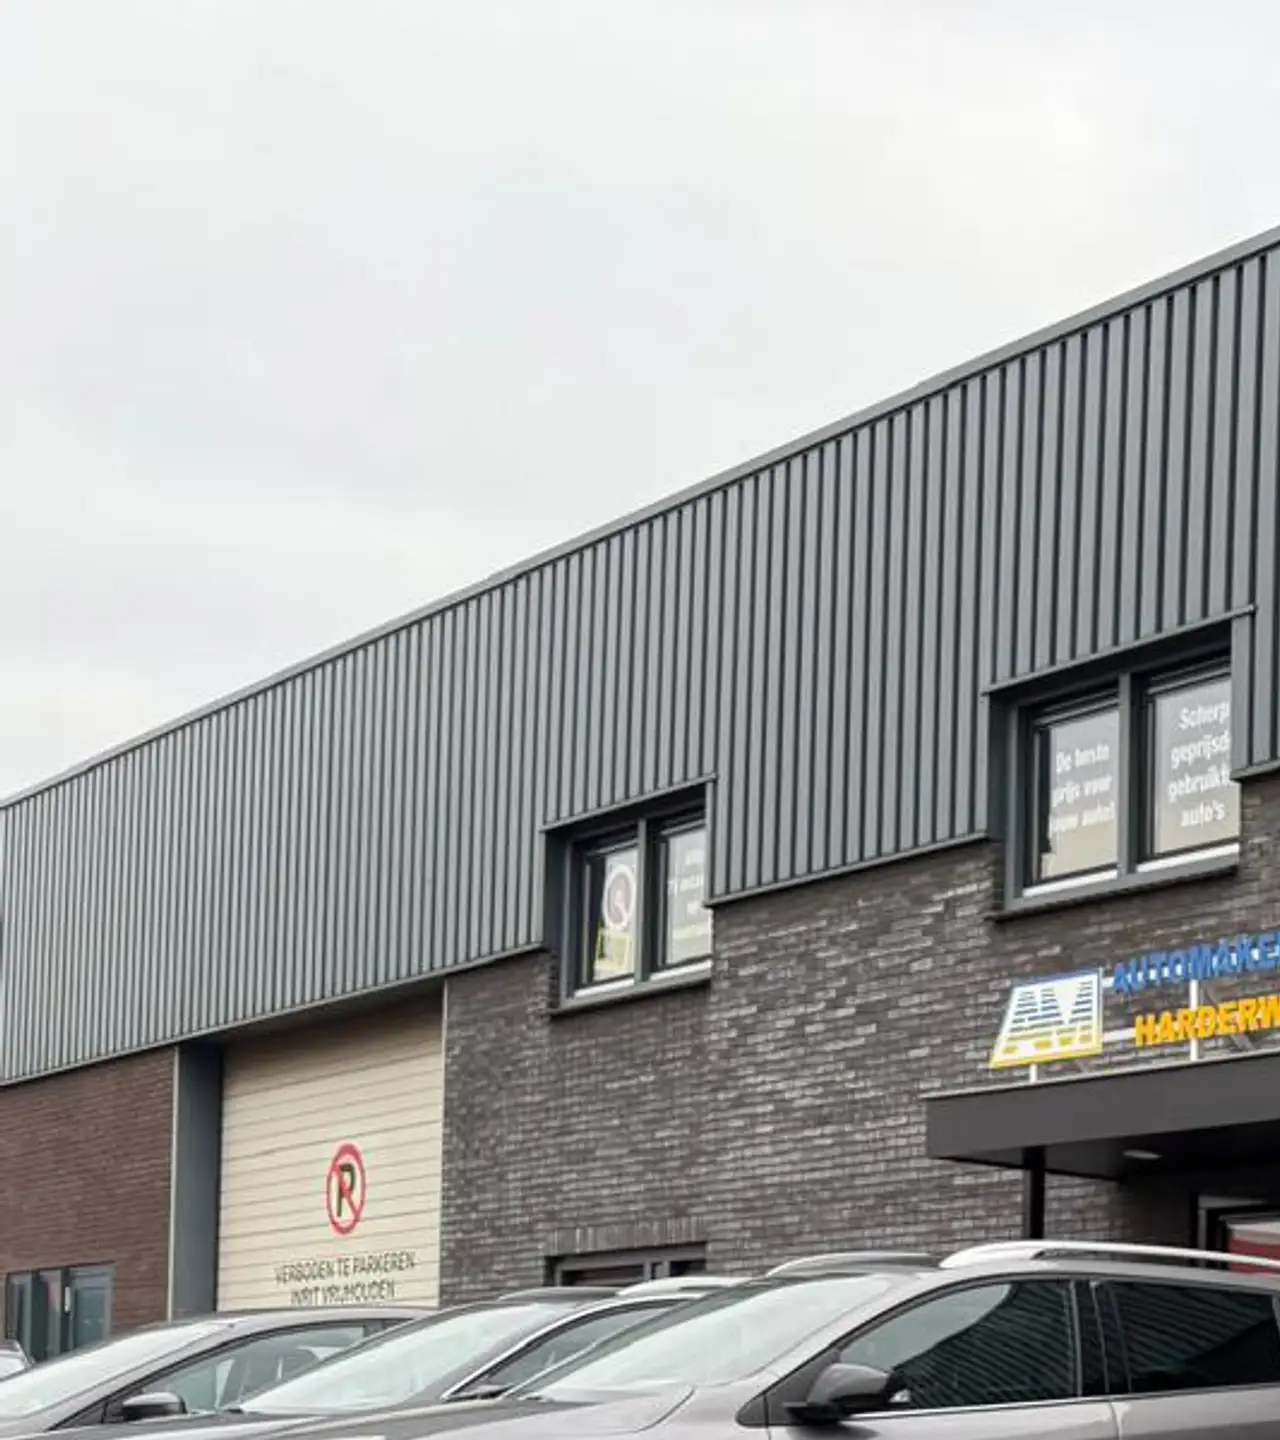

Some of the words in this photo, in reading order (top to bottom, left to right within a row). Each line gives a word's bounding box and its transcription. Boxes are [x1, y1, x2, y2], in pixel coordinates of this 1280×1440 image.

[274, 1259, 334, 1285] VERBODEN
[336, 1257, 351, 1277] TE
[352, 1250, 416, 1274] PARKEREN
